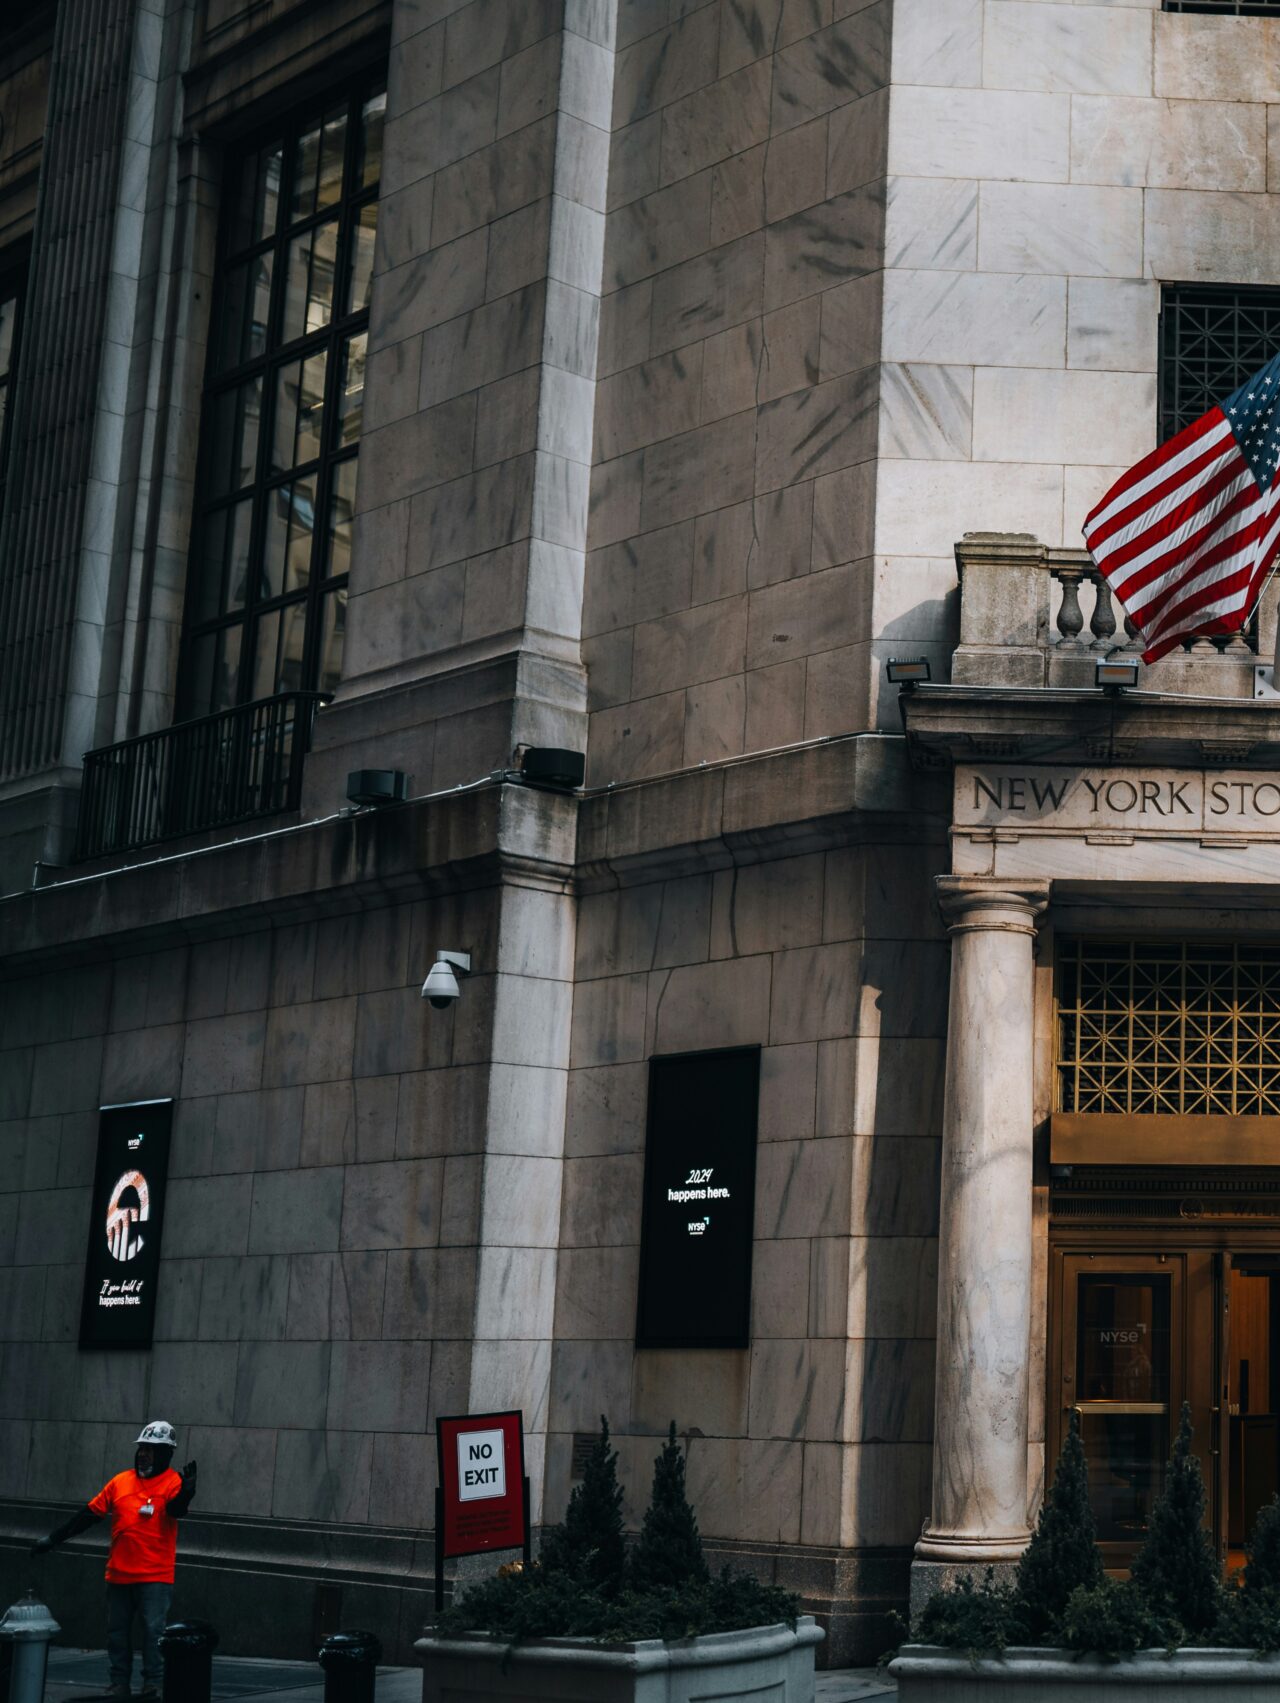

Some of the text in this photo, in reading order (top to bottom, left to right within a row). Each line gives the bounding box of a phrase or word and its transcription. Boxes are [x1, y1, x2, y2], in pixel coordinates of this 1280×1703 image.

[972, 776, 1070, 811] NEW
[1081, 779, 1195, 816] YORK
[685, 1168, 713, 1184] 2024
[668, 1186, 730, 1203] happens here.
[99, 1295, 125, 1308] happens
[469, 1443, 492, 1461] NO
[464, 1467, 499, 1486] EXIT
